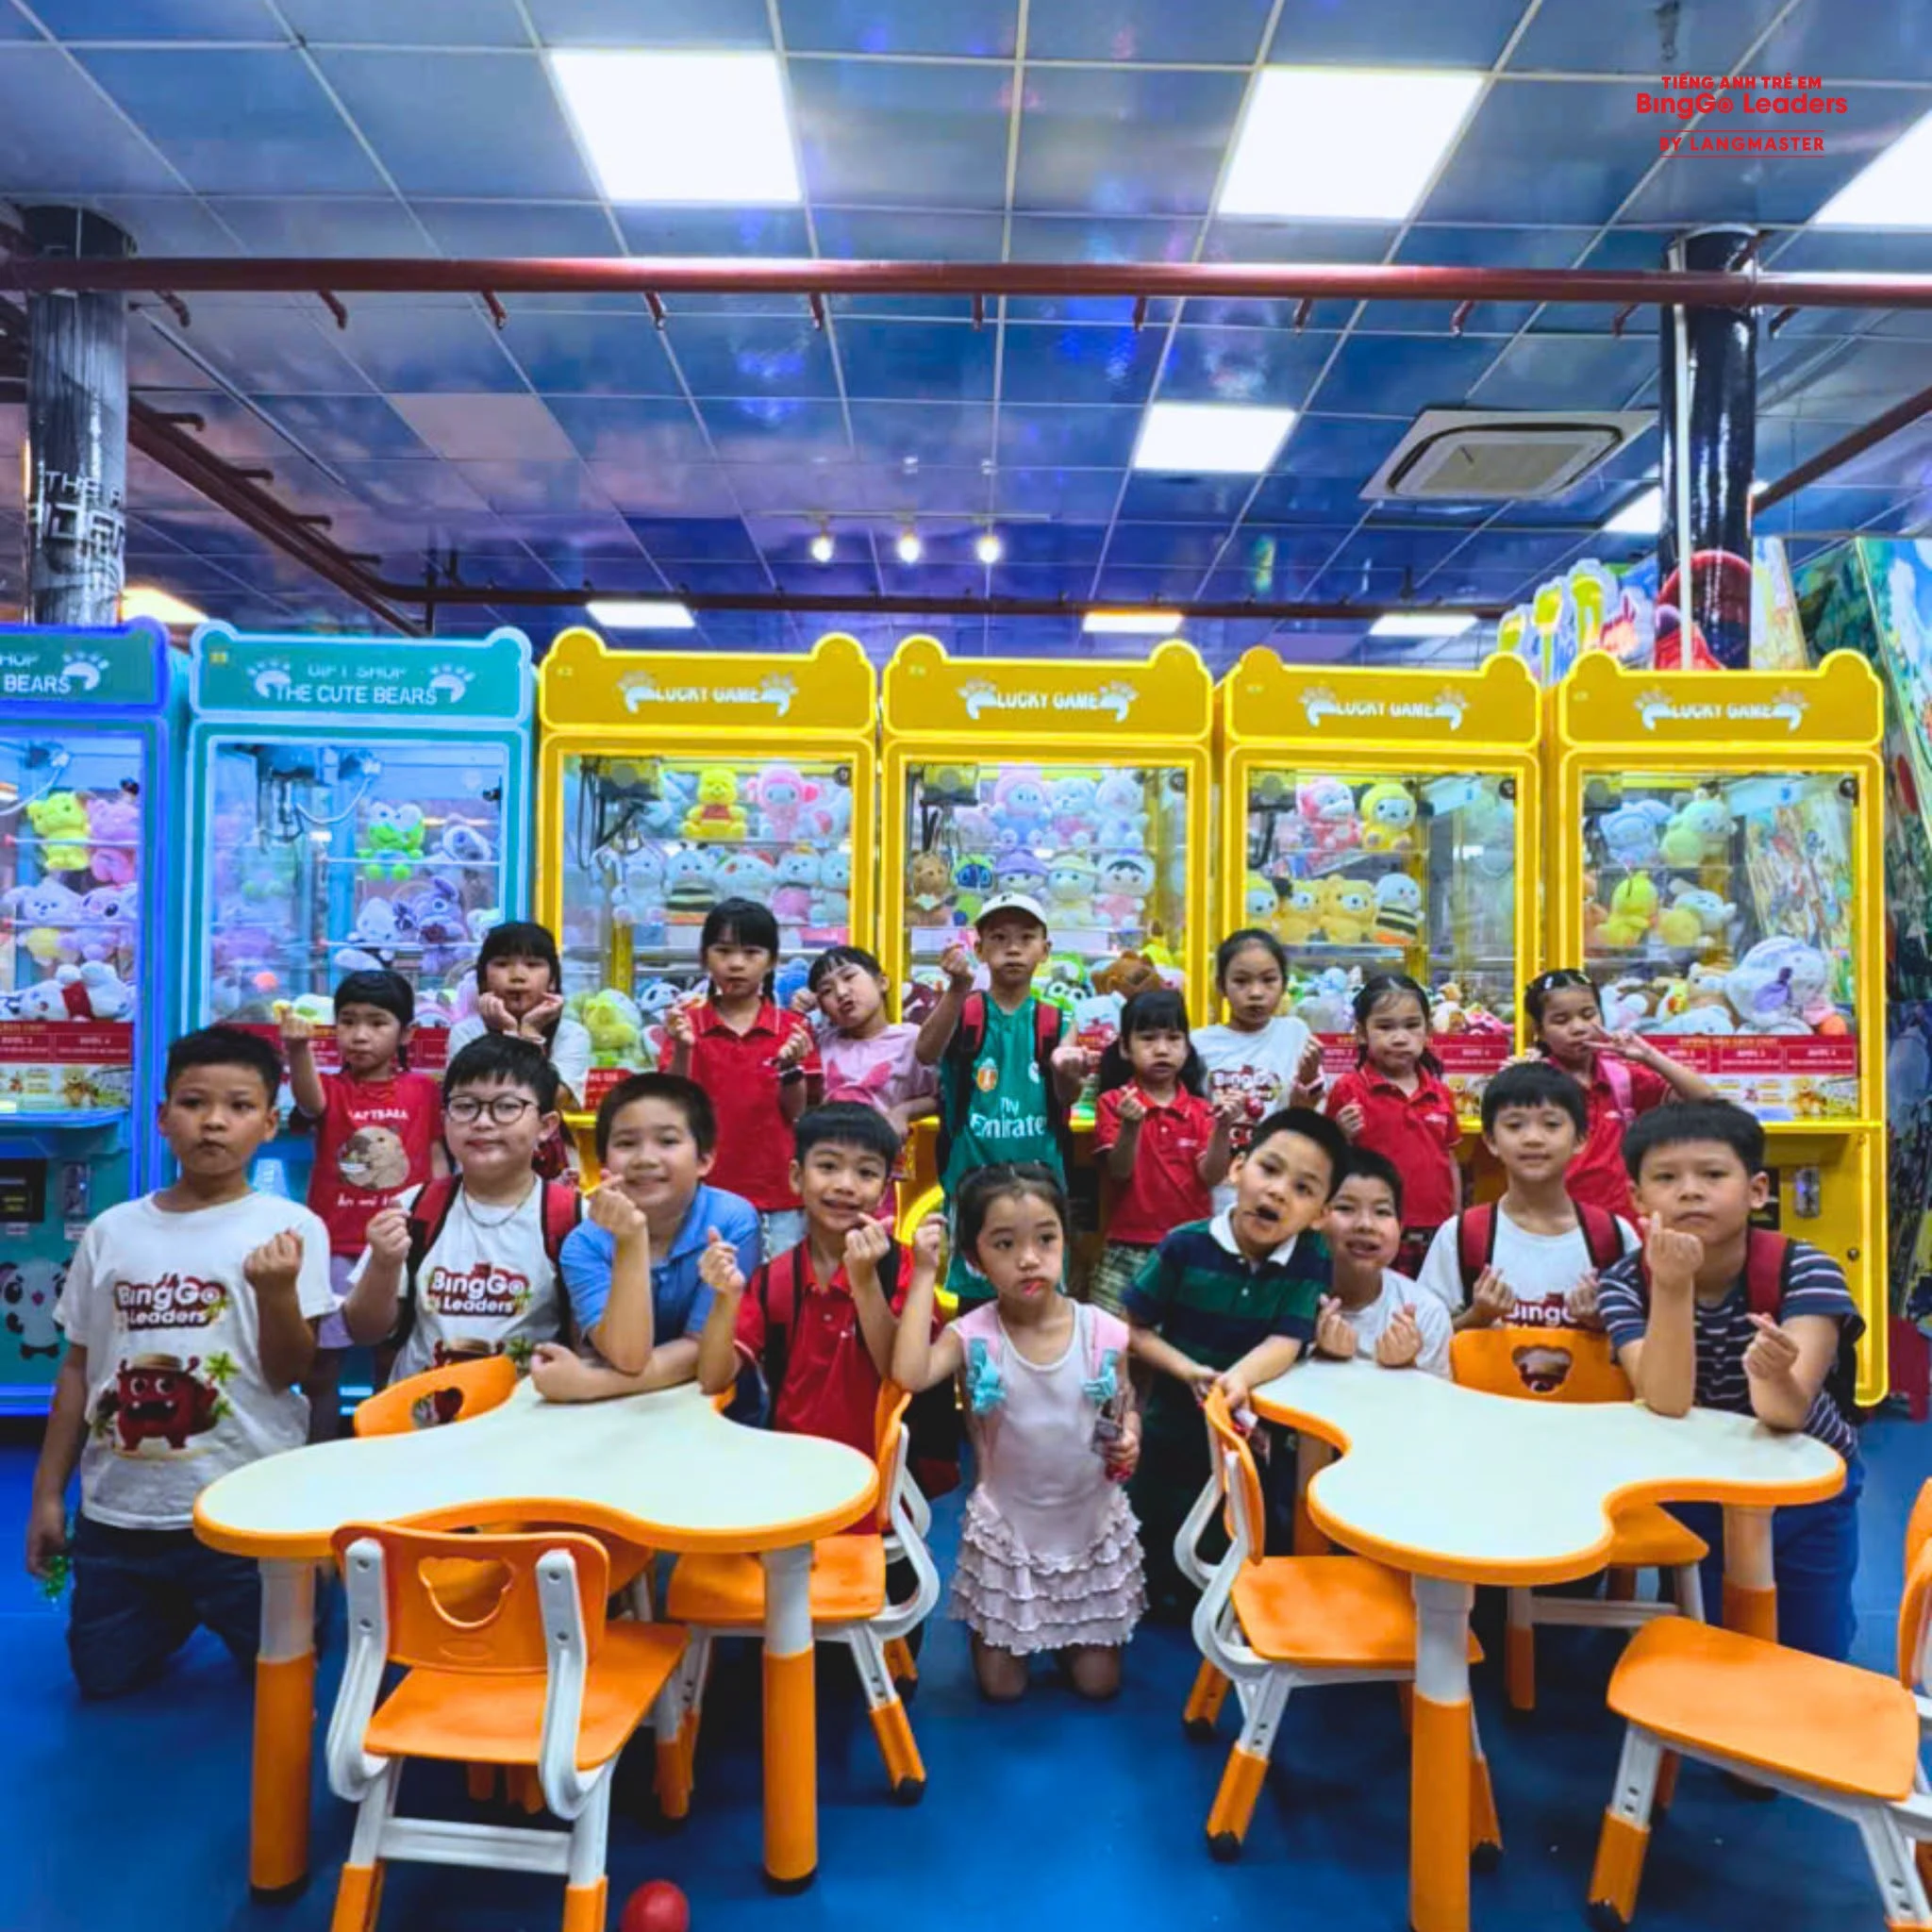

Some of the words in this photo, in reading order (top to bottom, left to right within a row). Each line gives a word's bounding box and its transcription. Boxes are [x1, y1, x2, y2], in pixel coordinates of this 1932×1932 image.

[4, 674, 72, 694] BEARS
[275, 683, 312, 702] THE
[317, 684, 368, 704] CUTE
[374, 686, 438, 706] BEARS
[444, 1297, 514, 1313] Leaders
[128, 1309, 207, 1325] Leaders
